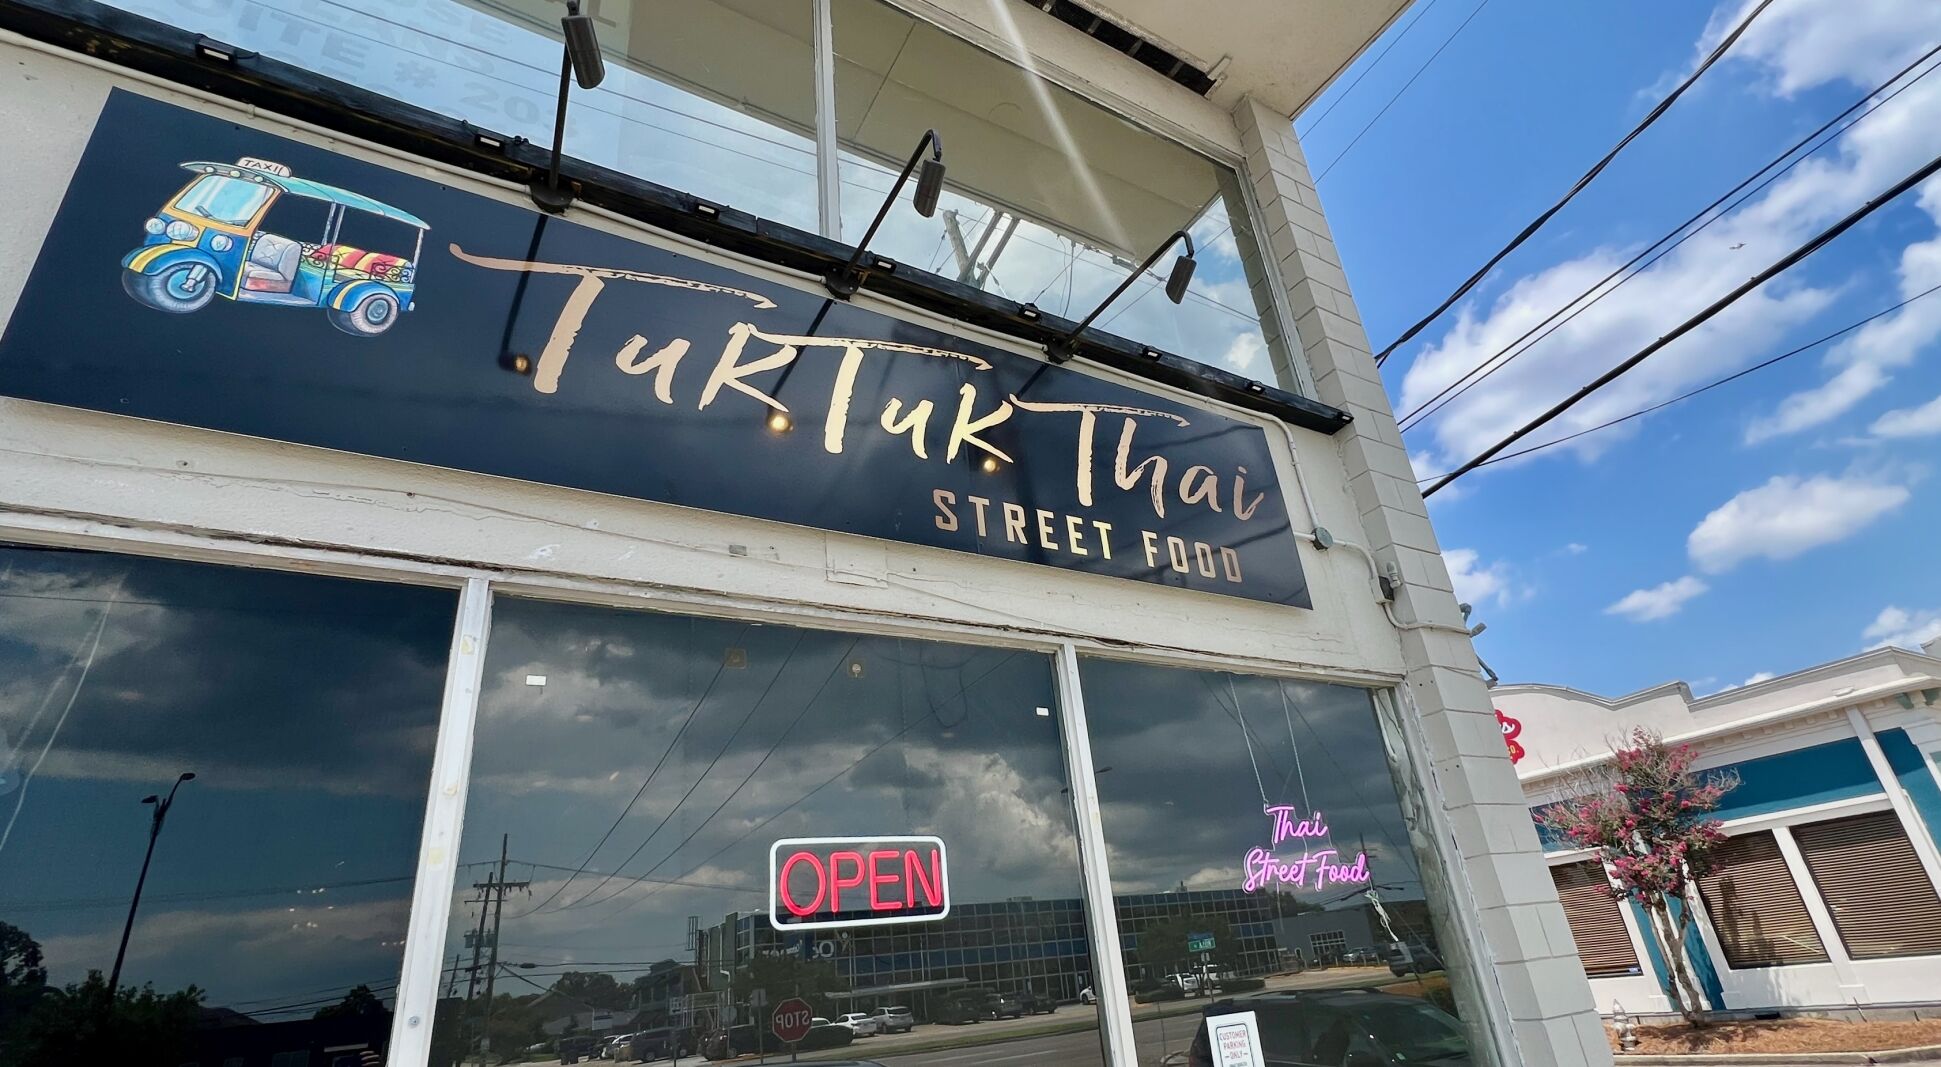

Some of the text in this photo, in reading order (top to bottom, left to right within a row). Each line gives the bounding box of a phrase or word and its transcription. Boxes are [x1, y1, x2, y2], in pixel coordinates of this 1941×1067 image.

[176, 0, 372, 69] UITE
[244, 159, 280, 174] TAXI
[1009, 393, 1265, 522] Thai
[932, 488, 1243, 584] STREET FOOD
[1266, 804, 1329, 844] Thai
[779, 848, 943, 916] OPEN
[1243, 847, 1371, 892] Street Food
[1219, 1029, 1247, 1041] CUSTOMER
[1223, 1040, 1247, 1051] PARKING
[1229, 1050, 1243, 1060] ONLY
